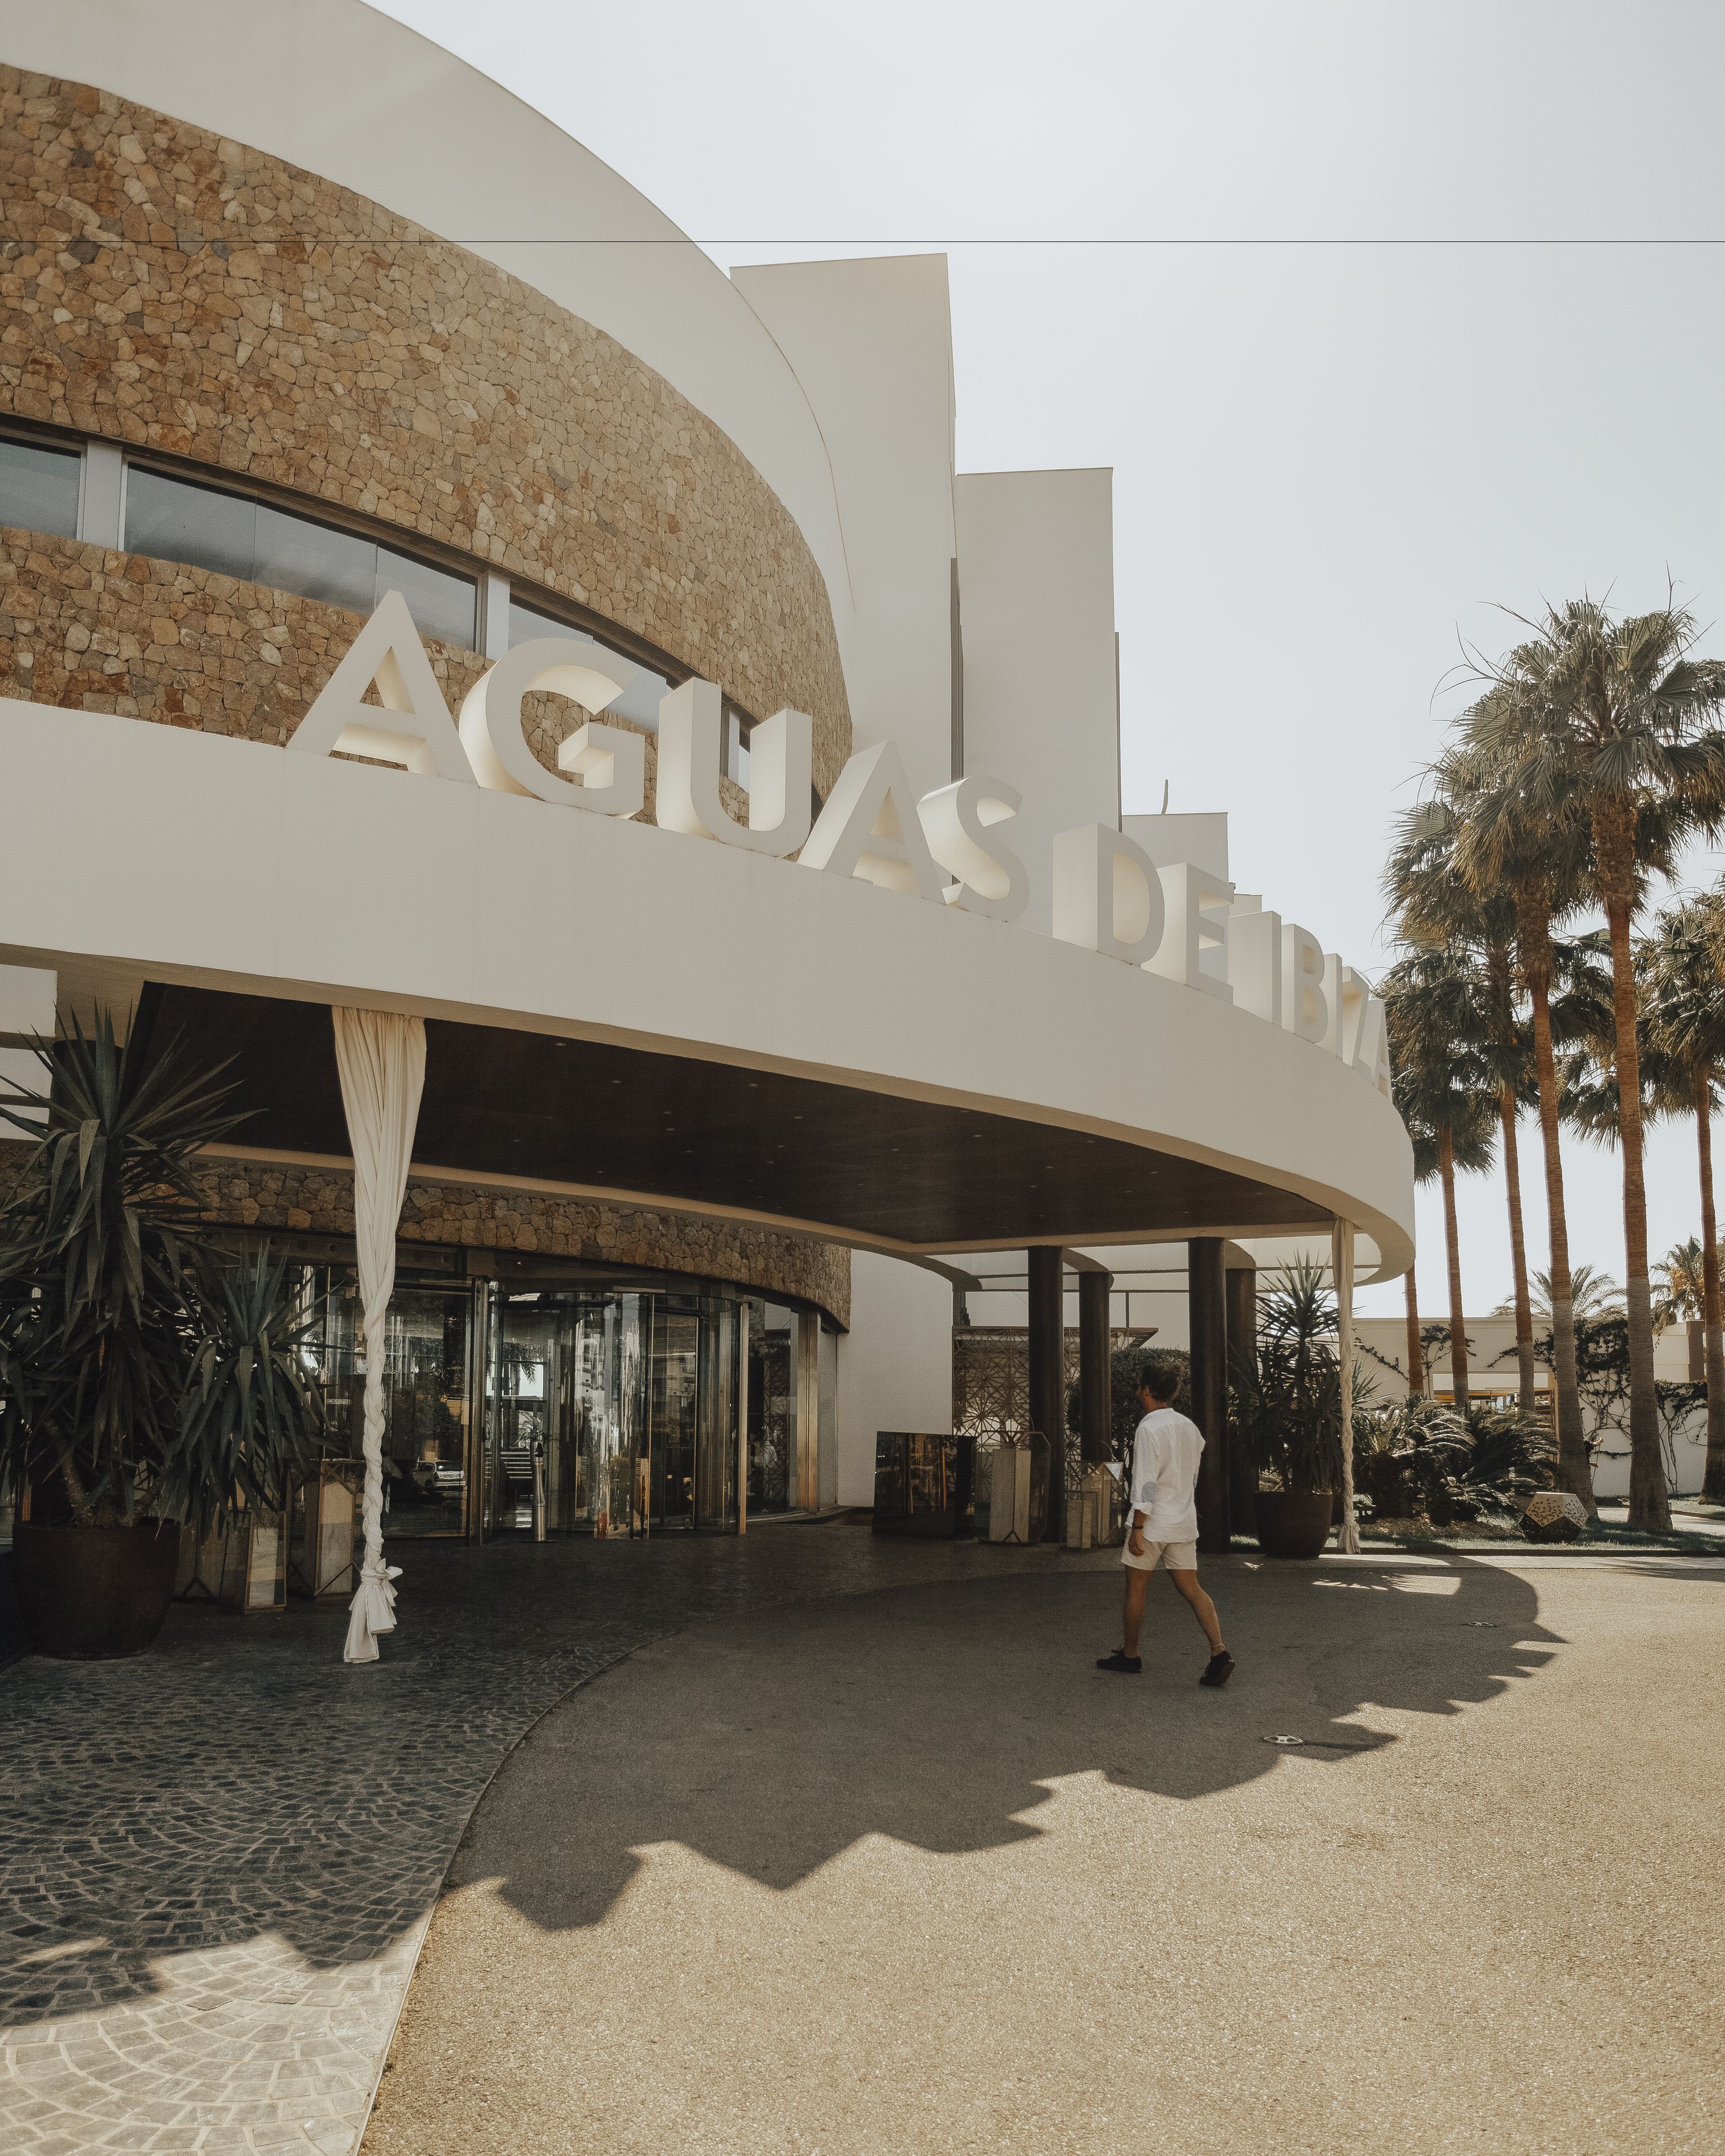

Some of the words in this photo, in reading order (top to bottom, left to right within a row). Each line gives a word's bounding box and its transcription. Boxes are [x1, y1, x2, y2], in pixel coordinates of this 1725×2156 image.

[285, 590, 1030, 922] AGUAS
[1052, 823, 1234, 1005] DE
[1227, 910, 1393, 1104] IBIZA
